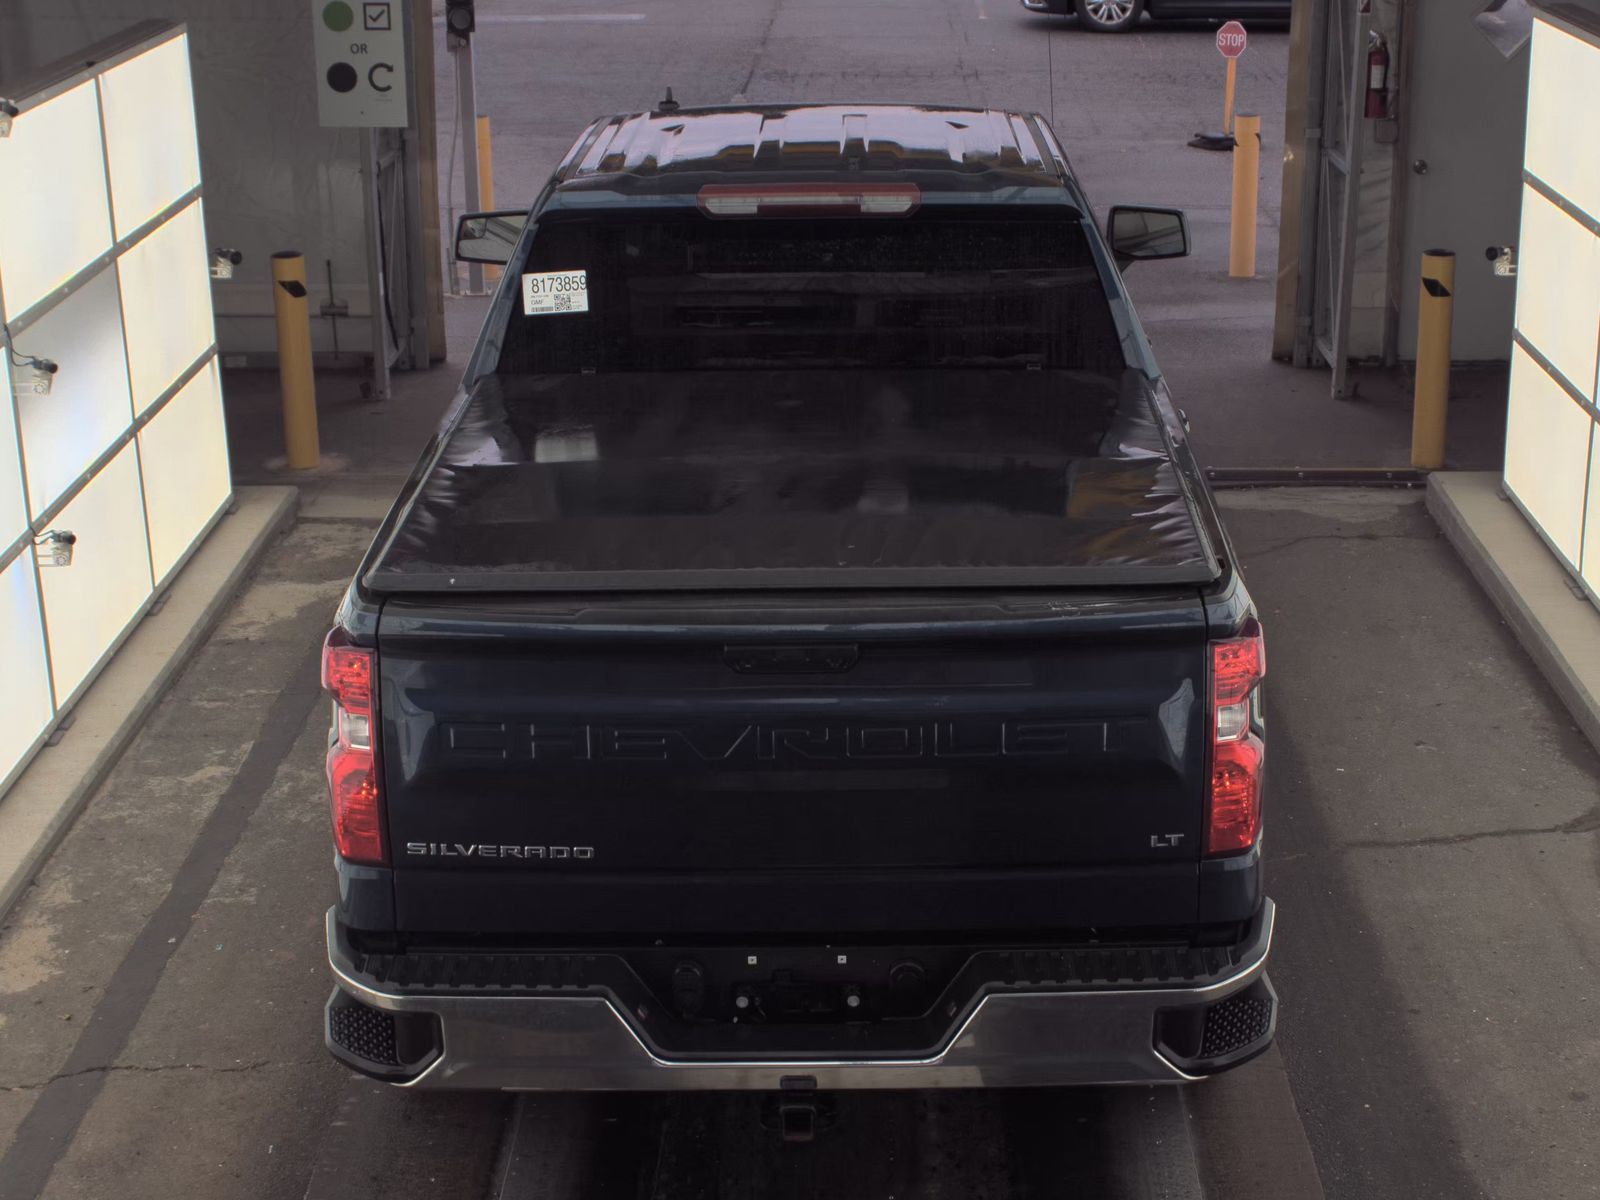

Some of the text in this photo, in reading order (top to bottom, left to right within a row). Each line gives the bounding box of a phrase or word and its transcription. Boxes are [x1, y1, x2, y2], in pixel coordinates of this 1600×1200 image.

[1218, 33, 1244, 46] STOP
[350, 43, 368, 54] OR
[531, 275, 587, 293] 8173859
[441, 718, 1148, 760] CHEVROLET
[1150, 833, 1185, 848] LT
[406, 842, 595, 859] SILVERADO
